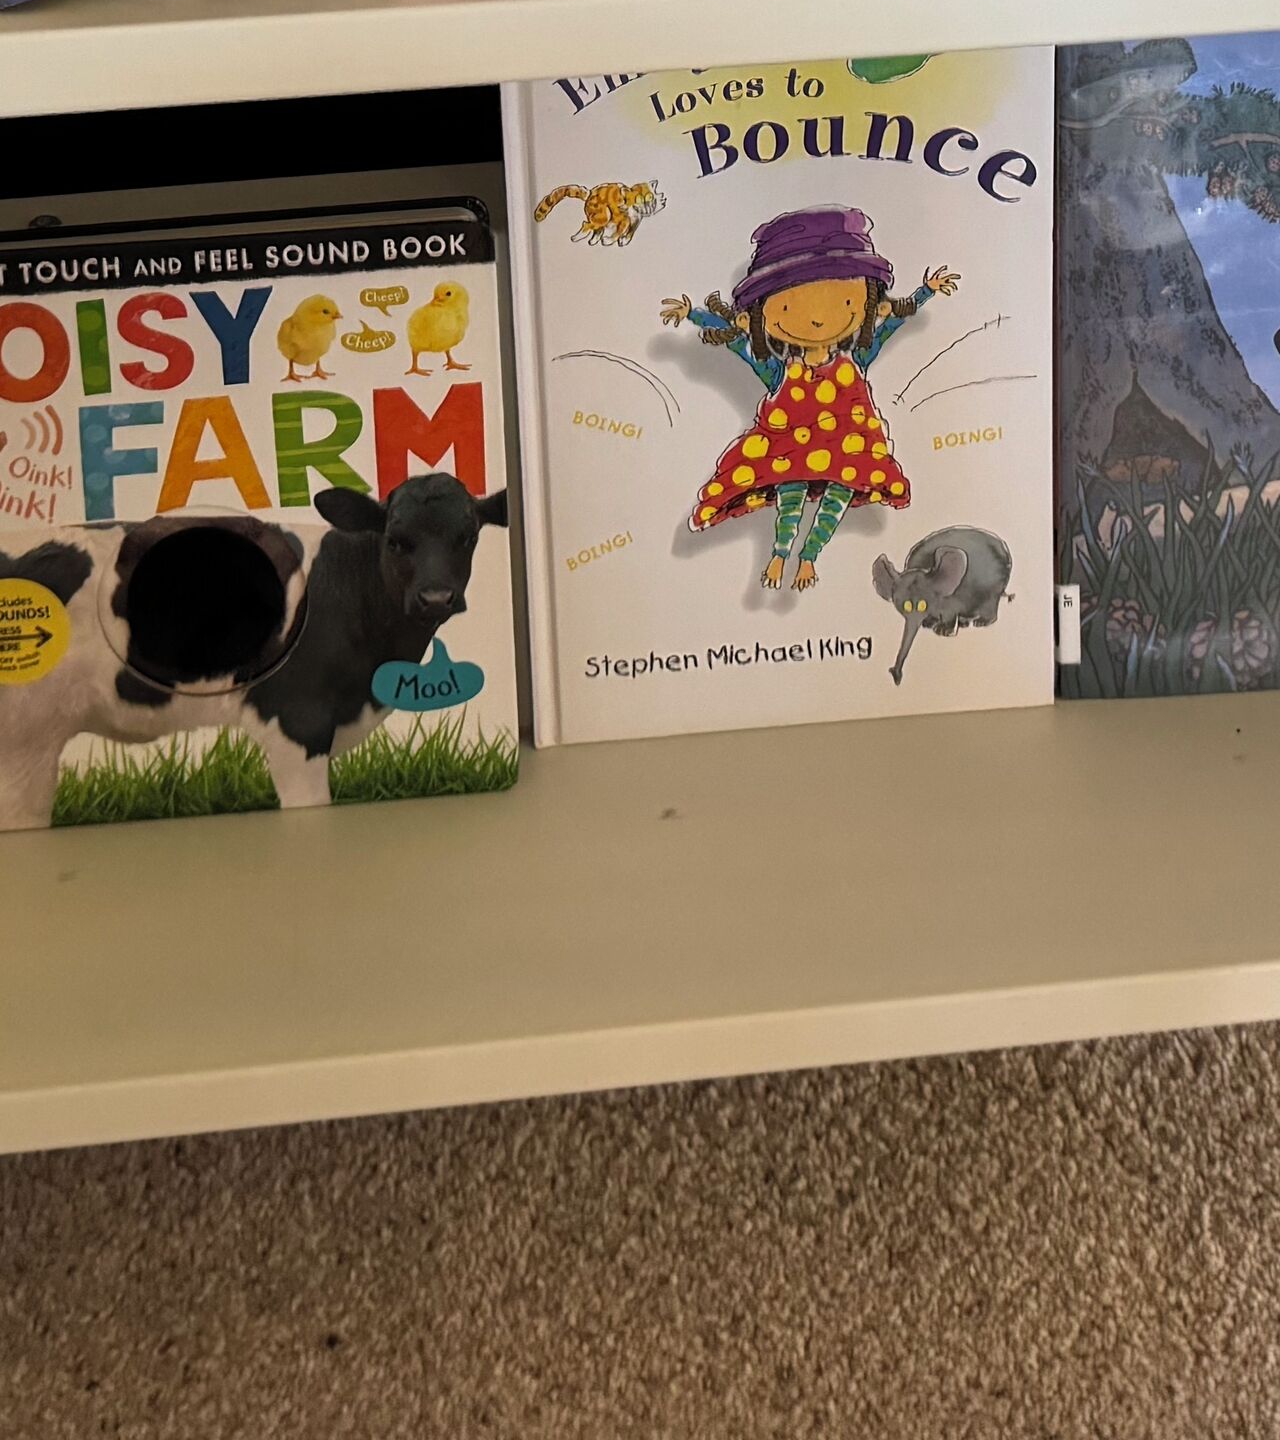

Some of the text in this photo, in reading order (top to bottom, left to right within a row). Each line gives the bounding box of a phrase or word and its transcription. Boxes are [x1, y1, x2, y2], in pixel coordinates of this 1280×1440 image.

[648, 76, 765, 124] Loves
[784, 66, 826, 99] to
[682, 109, 1039, 205] Bounce
[18, 257, 122, 285] TOUCH
[133, 255, 184, 278] AND
[193, 247, 255, 274] FEEL
[264, 240, 371, 269] SOUND
[382, 232, 468, 260] BOOK
[363, 287, 407, 305] Cheep!
[343, 329, 395, 351] Cheep!
[77, 381, 488, 522] FARM
[7, 454, 75, 492] Oink!
[1061, 592, 1074, 609] JE
[583, 635, 874, 679] Stephen Michael King
[394, 672, 462, 702] Moo!
